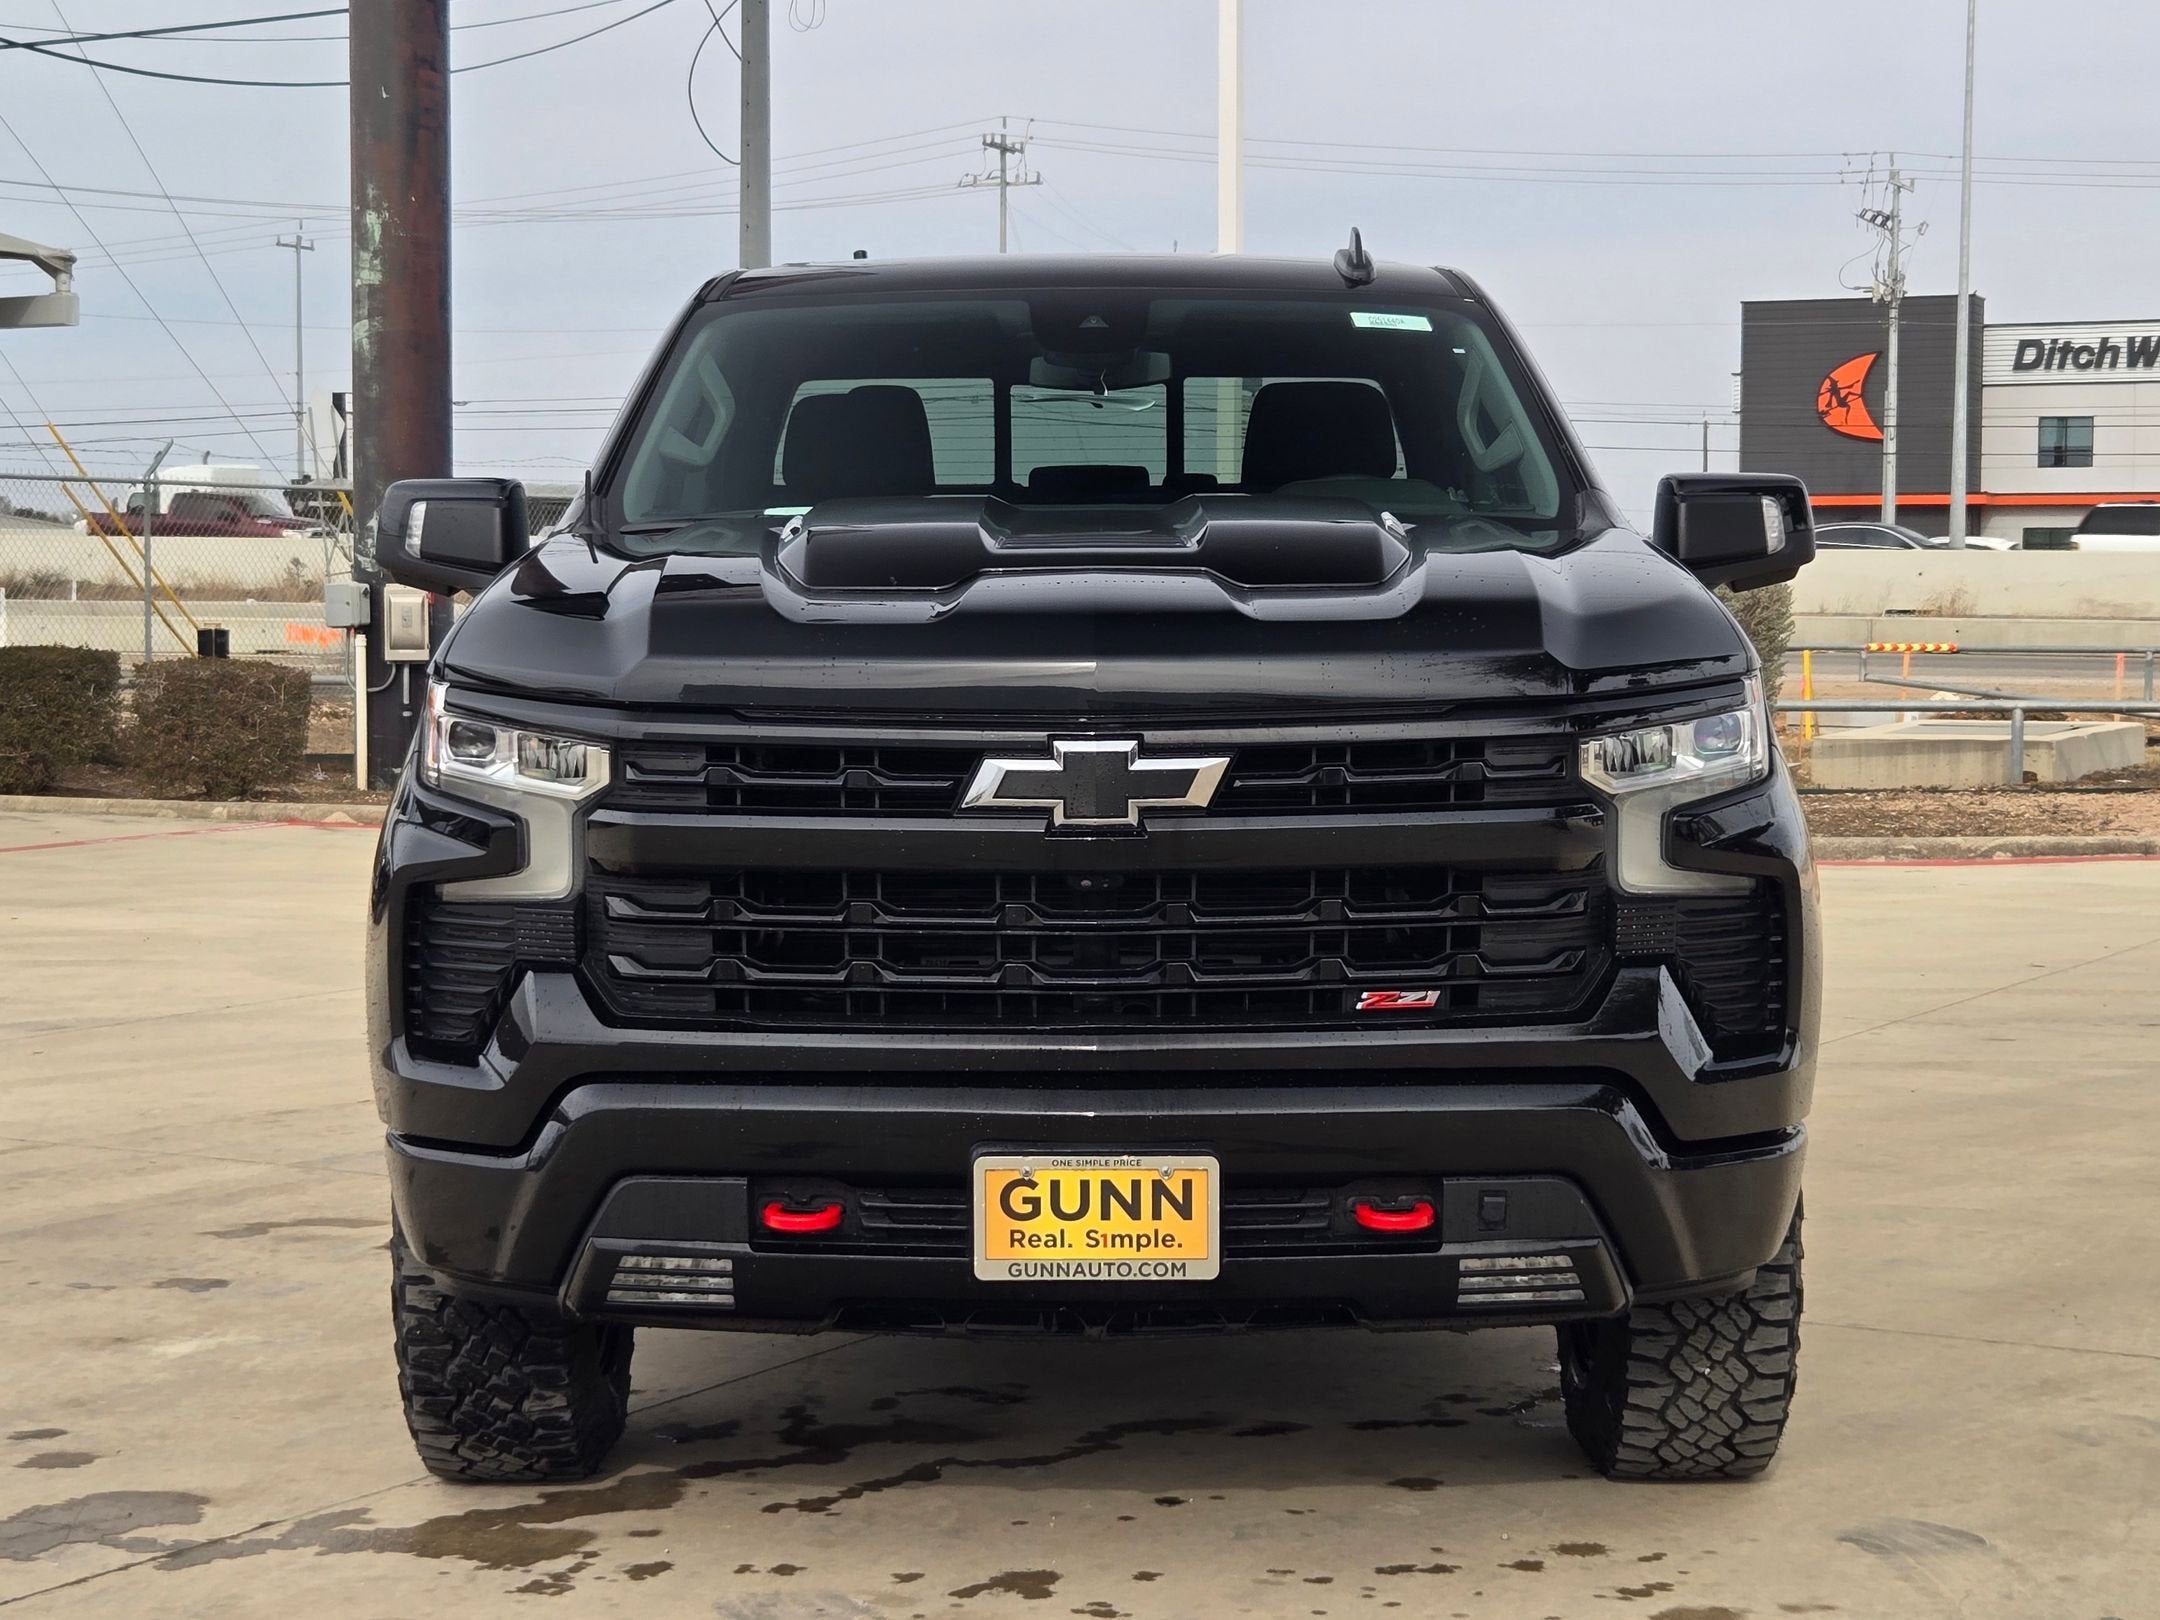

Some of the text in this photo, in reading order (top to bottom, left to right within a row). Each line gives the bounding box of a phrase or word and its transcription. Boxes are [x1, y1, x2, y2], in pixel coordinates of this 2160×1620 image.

[2012, 337, 2121, 370] Ditch
[1355, 991, 1440, 1010] Z71
[1052, 1159, 1142, 1167] ONE SIMPLE PRICE
[999, 1177, 1193, 1221] GUNN
[1009, 1229, 1073, 1248] Real.
[1007, 1262, 1187, 1278] GUNNAUTO.COM
